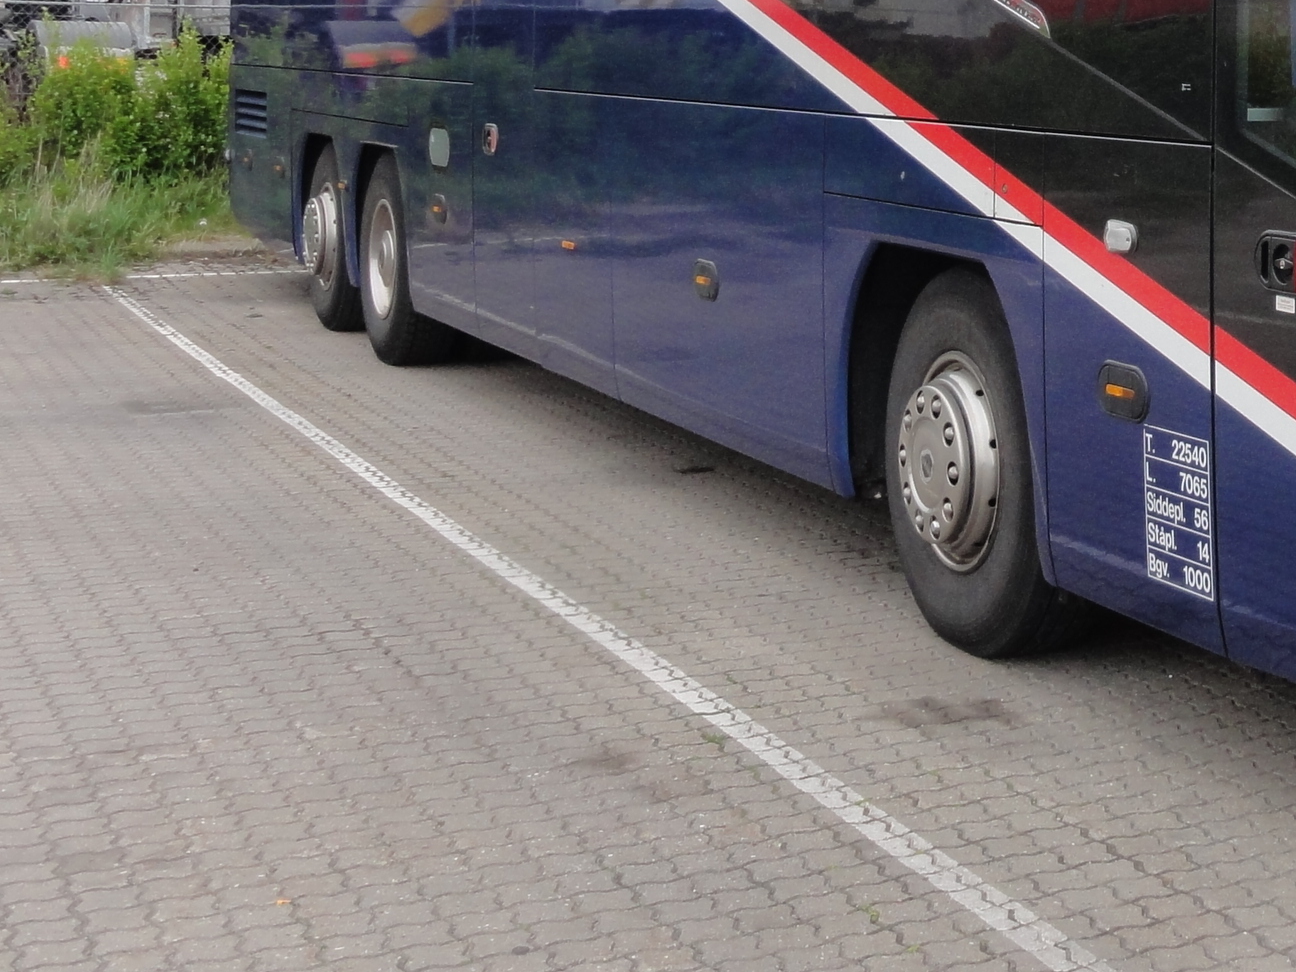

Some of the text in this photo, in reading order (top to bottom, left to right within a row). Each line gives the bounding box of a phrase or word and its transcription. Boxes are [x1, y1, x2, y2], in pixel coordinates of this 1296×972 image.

[1145, 433, 1207, 467] T. 22540
[1146, 461, 1208, 499] L. 7065
[1147, 491, 1209, 530] Siddepl. 56
[1148, 522, 1210, 563] Ståpl. 14
[1149, 552, 1211, 593] Bgv. 1000
